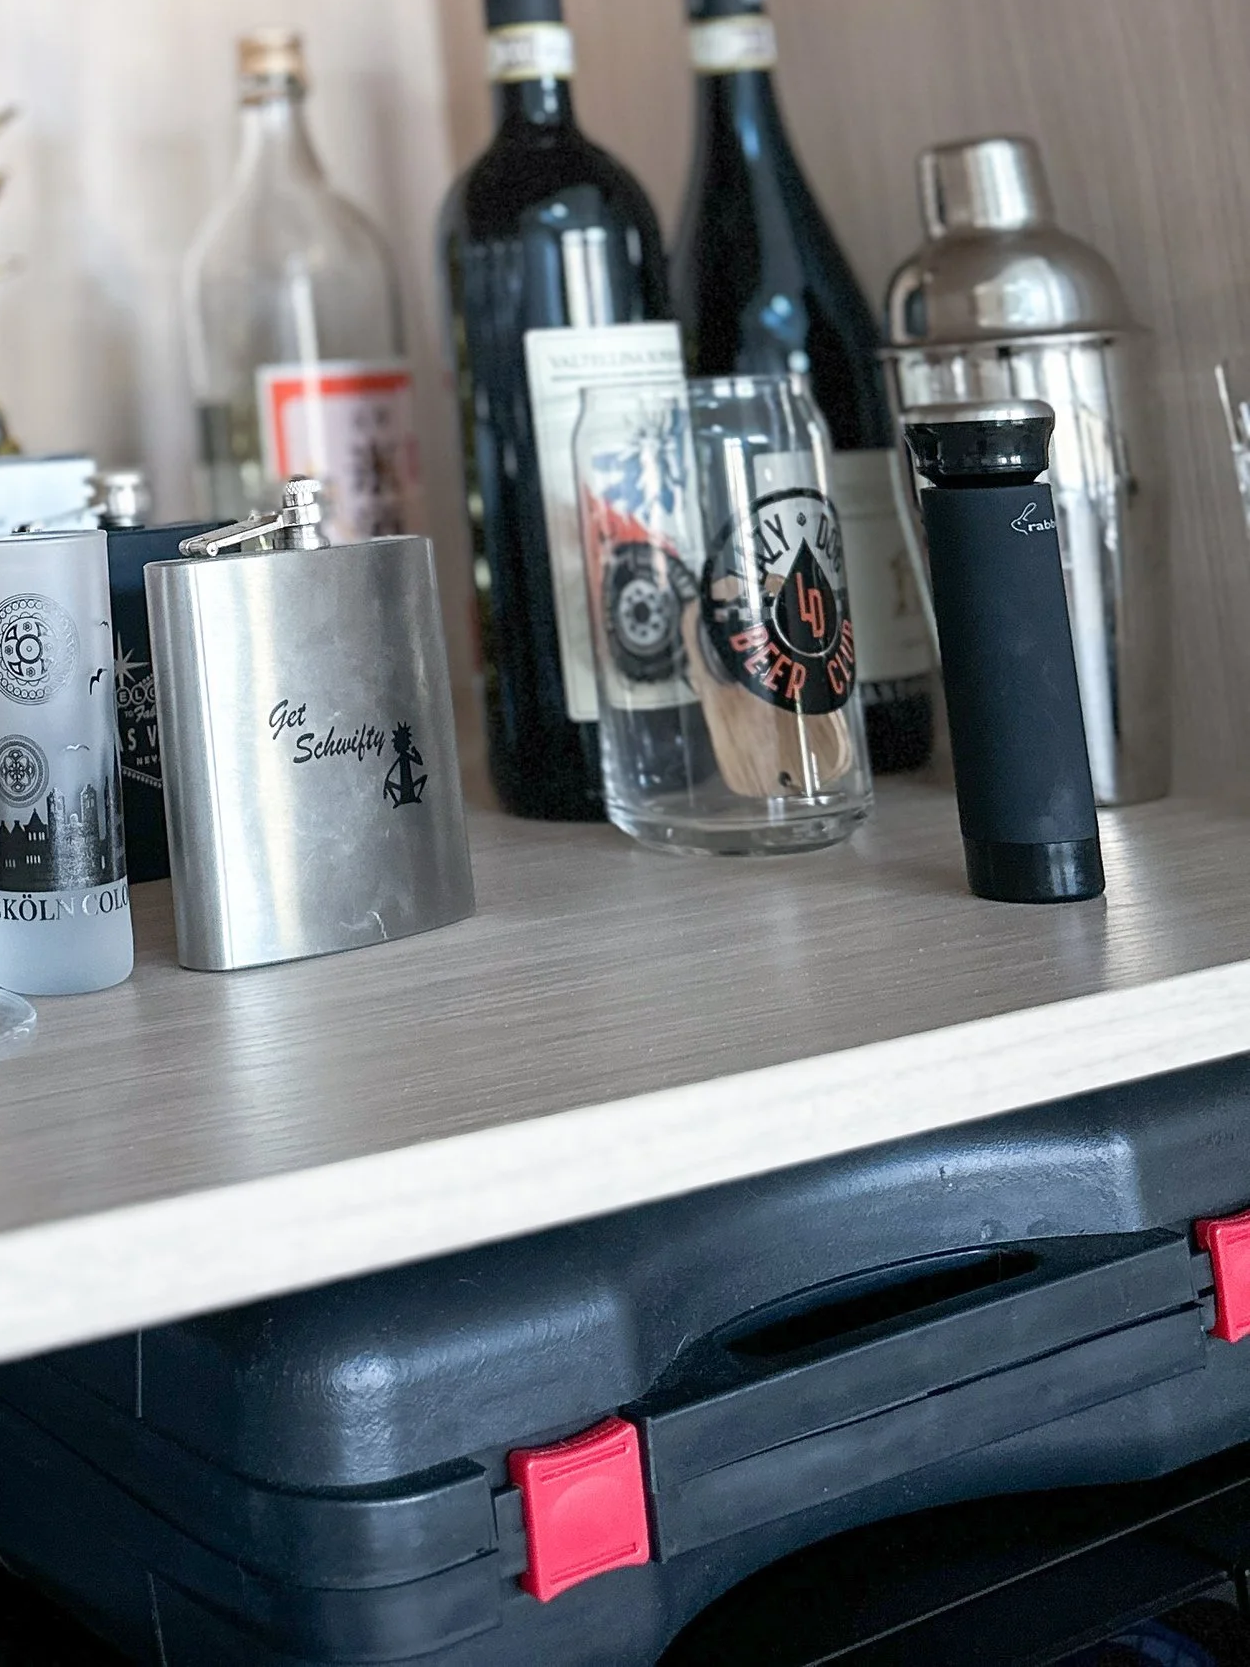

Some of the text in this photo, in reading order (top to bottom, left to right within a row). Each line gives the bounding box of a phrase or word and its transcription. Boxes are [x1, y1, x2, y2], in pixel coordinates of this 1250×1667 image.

[729, 622, 807, 700] BEER
[269, 699, 306, 740] Get
[293, 723, 386, 763] Schwifty
